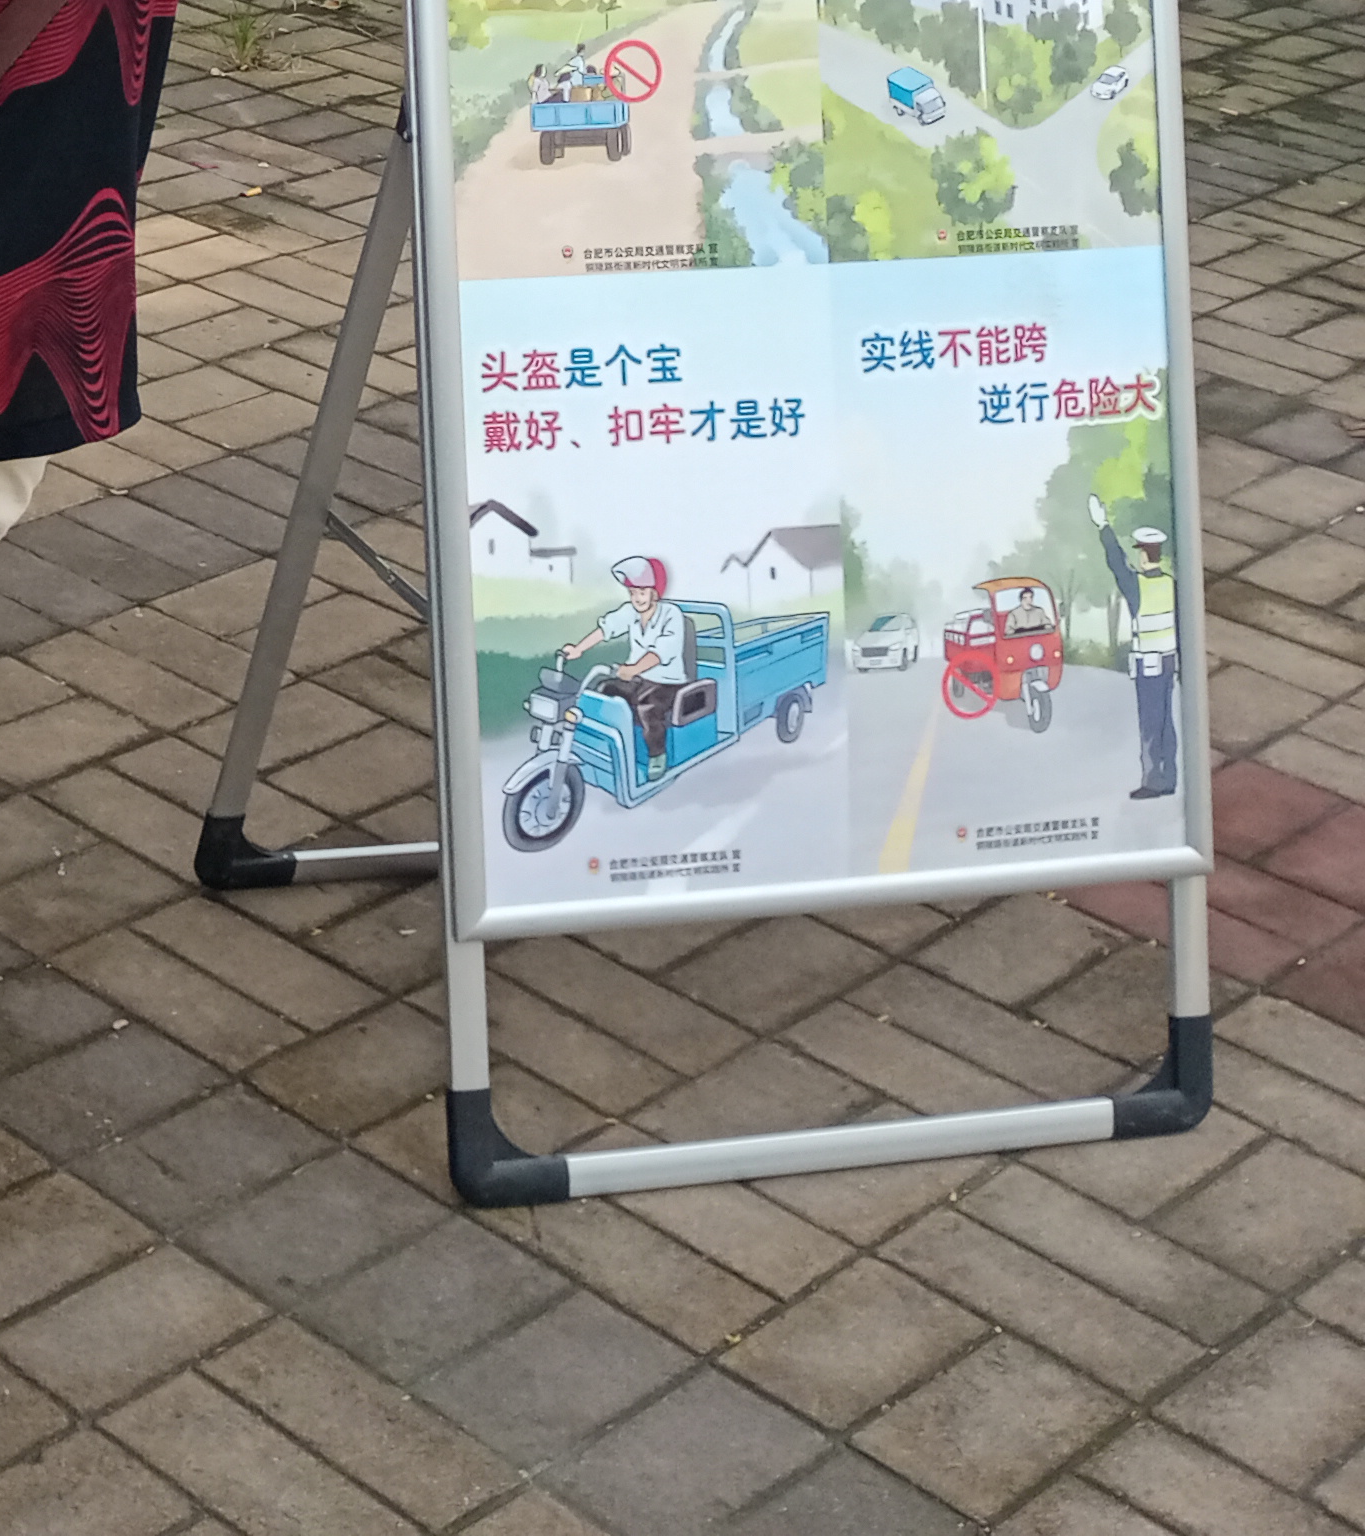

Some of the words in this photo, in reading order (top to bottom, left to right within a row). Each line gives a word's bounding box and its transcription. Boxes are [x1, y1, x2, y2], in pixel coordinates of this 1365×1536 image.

[481, 343, 683, 393] 头盔是个宝
[861, 322, 1048, 373] 实线不能跨
[978, 374, 1157, 424] 逆行危险大
[483, 397, 806, 454] 戴好、扣牢才是好
